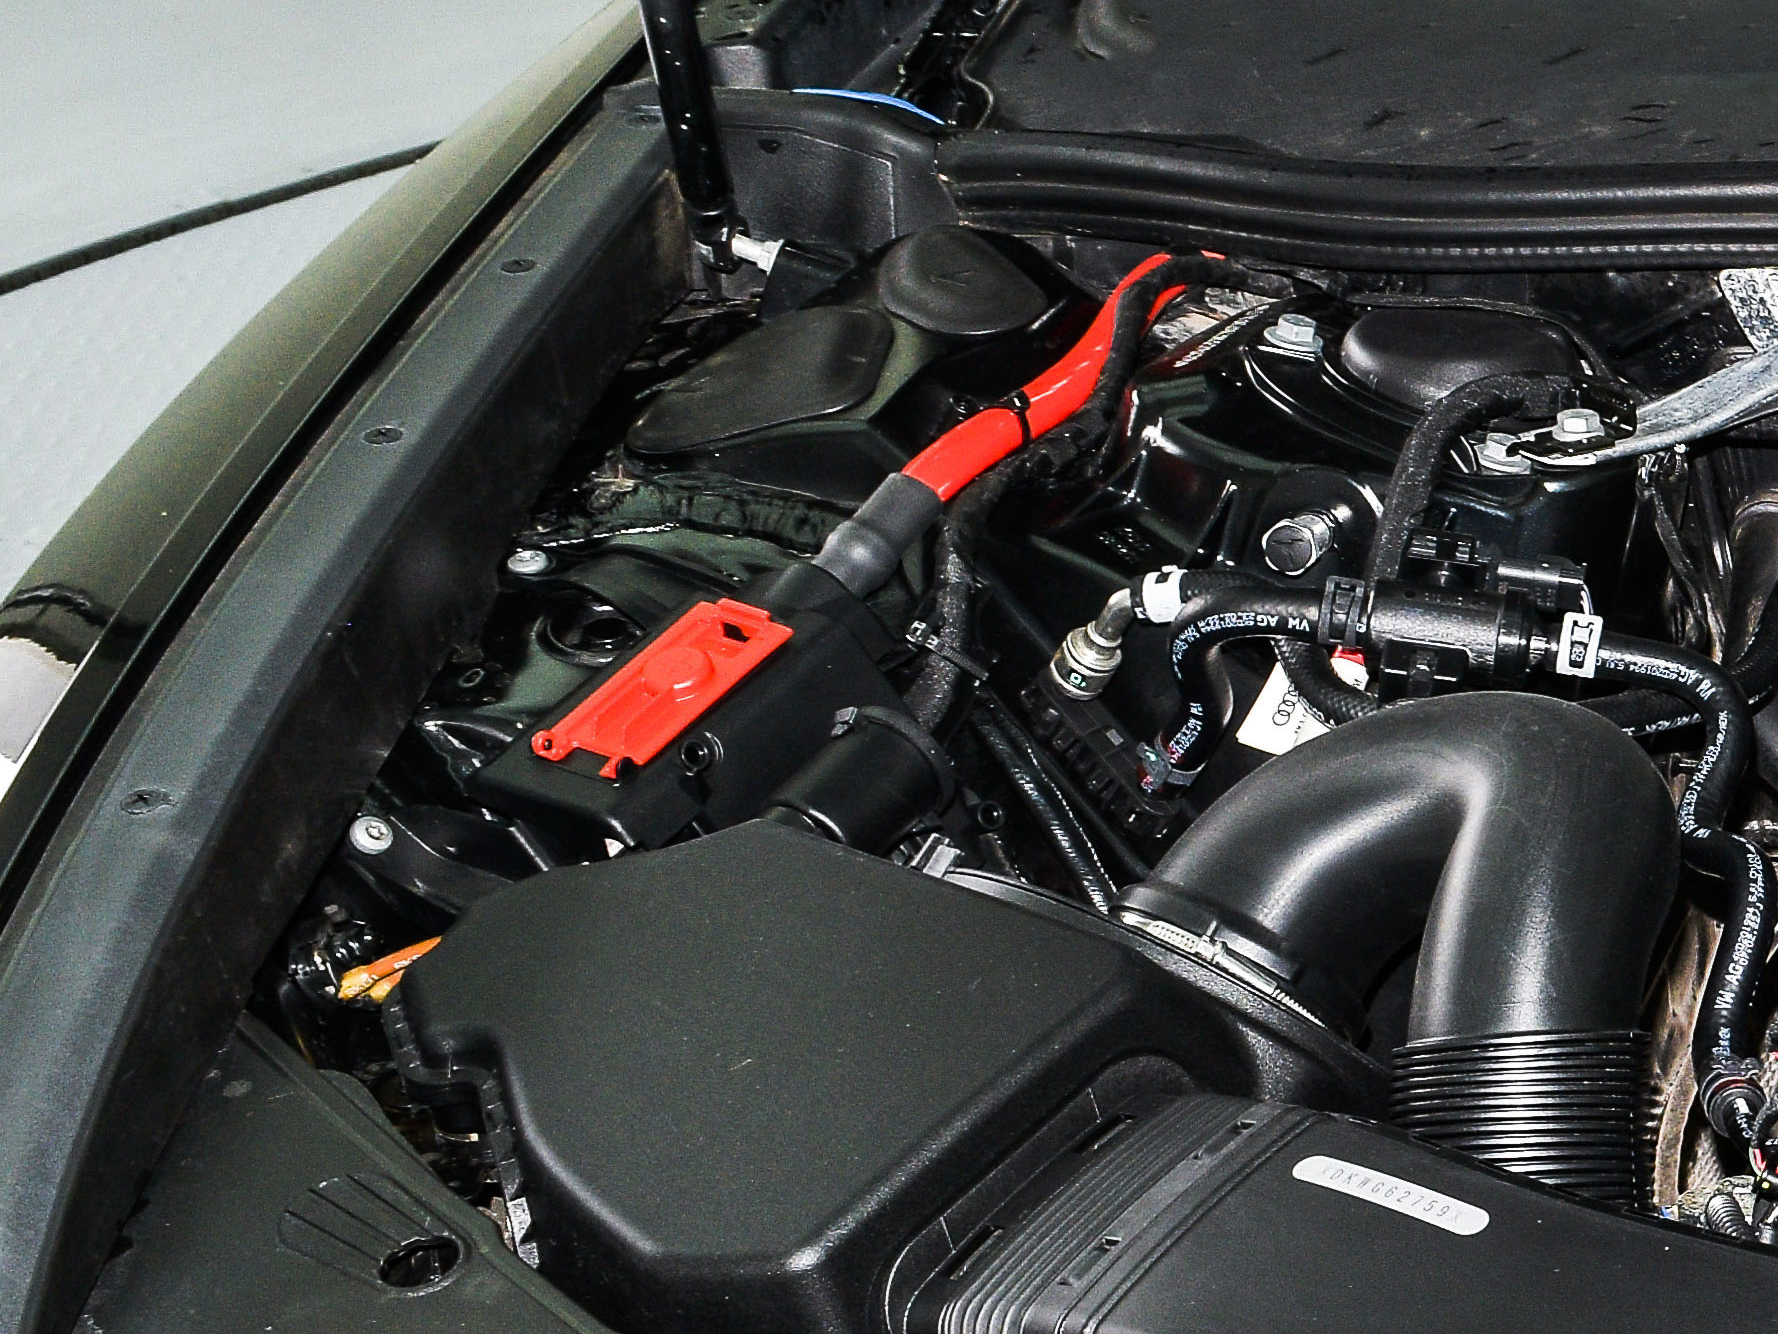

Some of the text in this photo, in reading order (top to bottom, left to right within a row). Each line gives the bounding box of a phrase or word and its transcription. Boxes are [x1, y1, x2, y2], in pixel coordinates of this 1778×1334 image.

[1256, 615, 1310, 632] VW AG
[1714, 990, 1736, 1010] VW
[1725, 962, 1744, 986] AG
